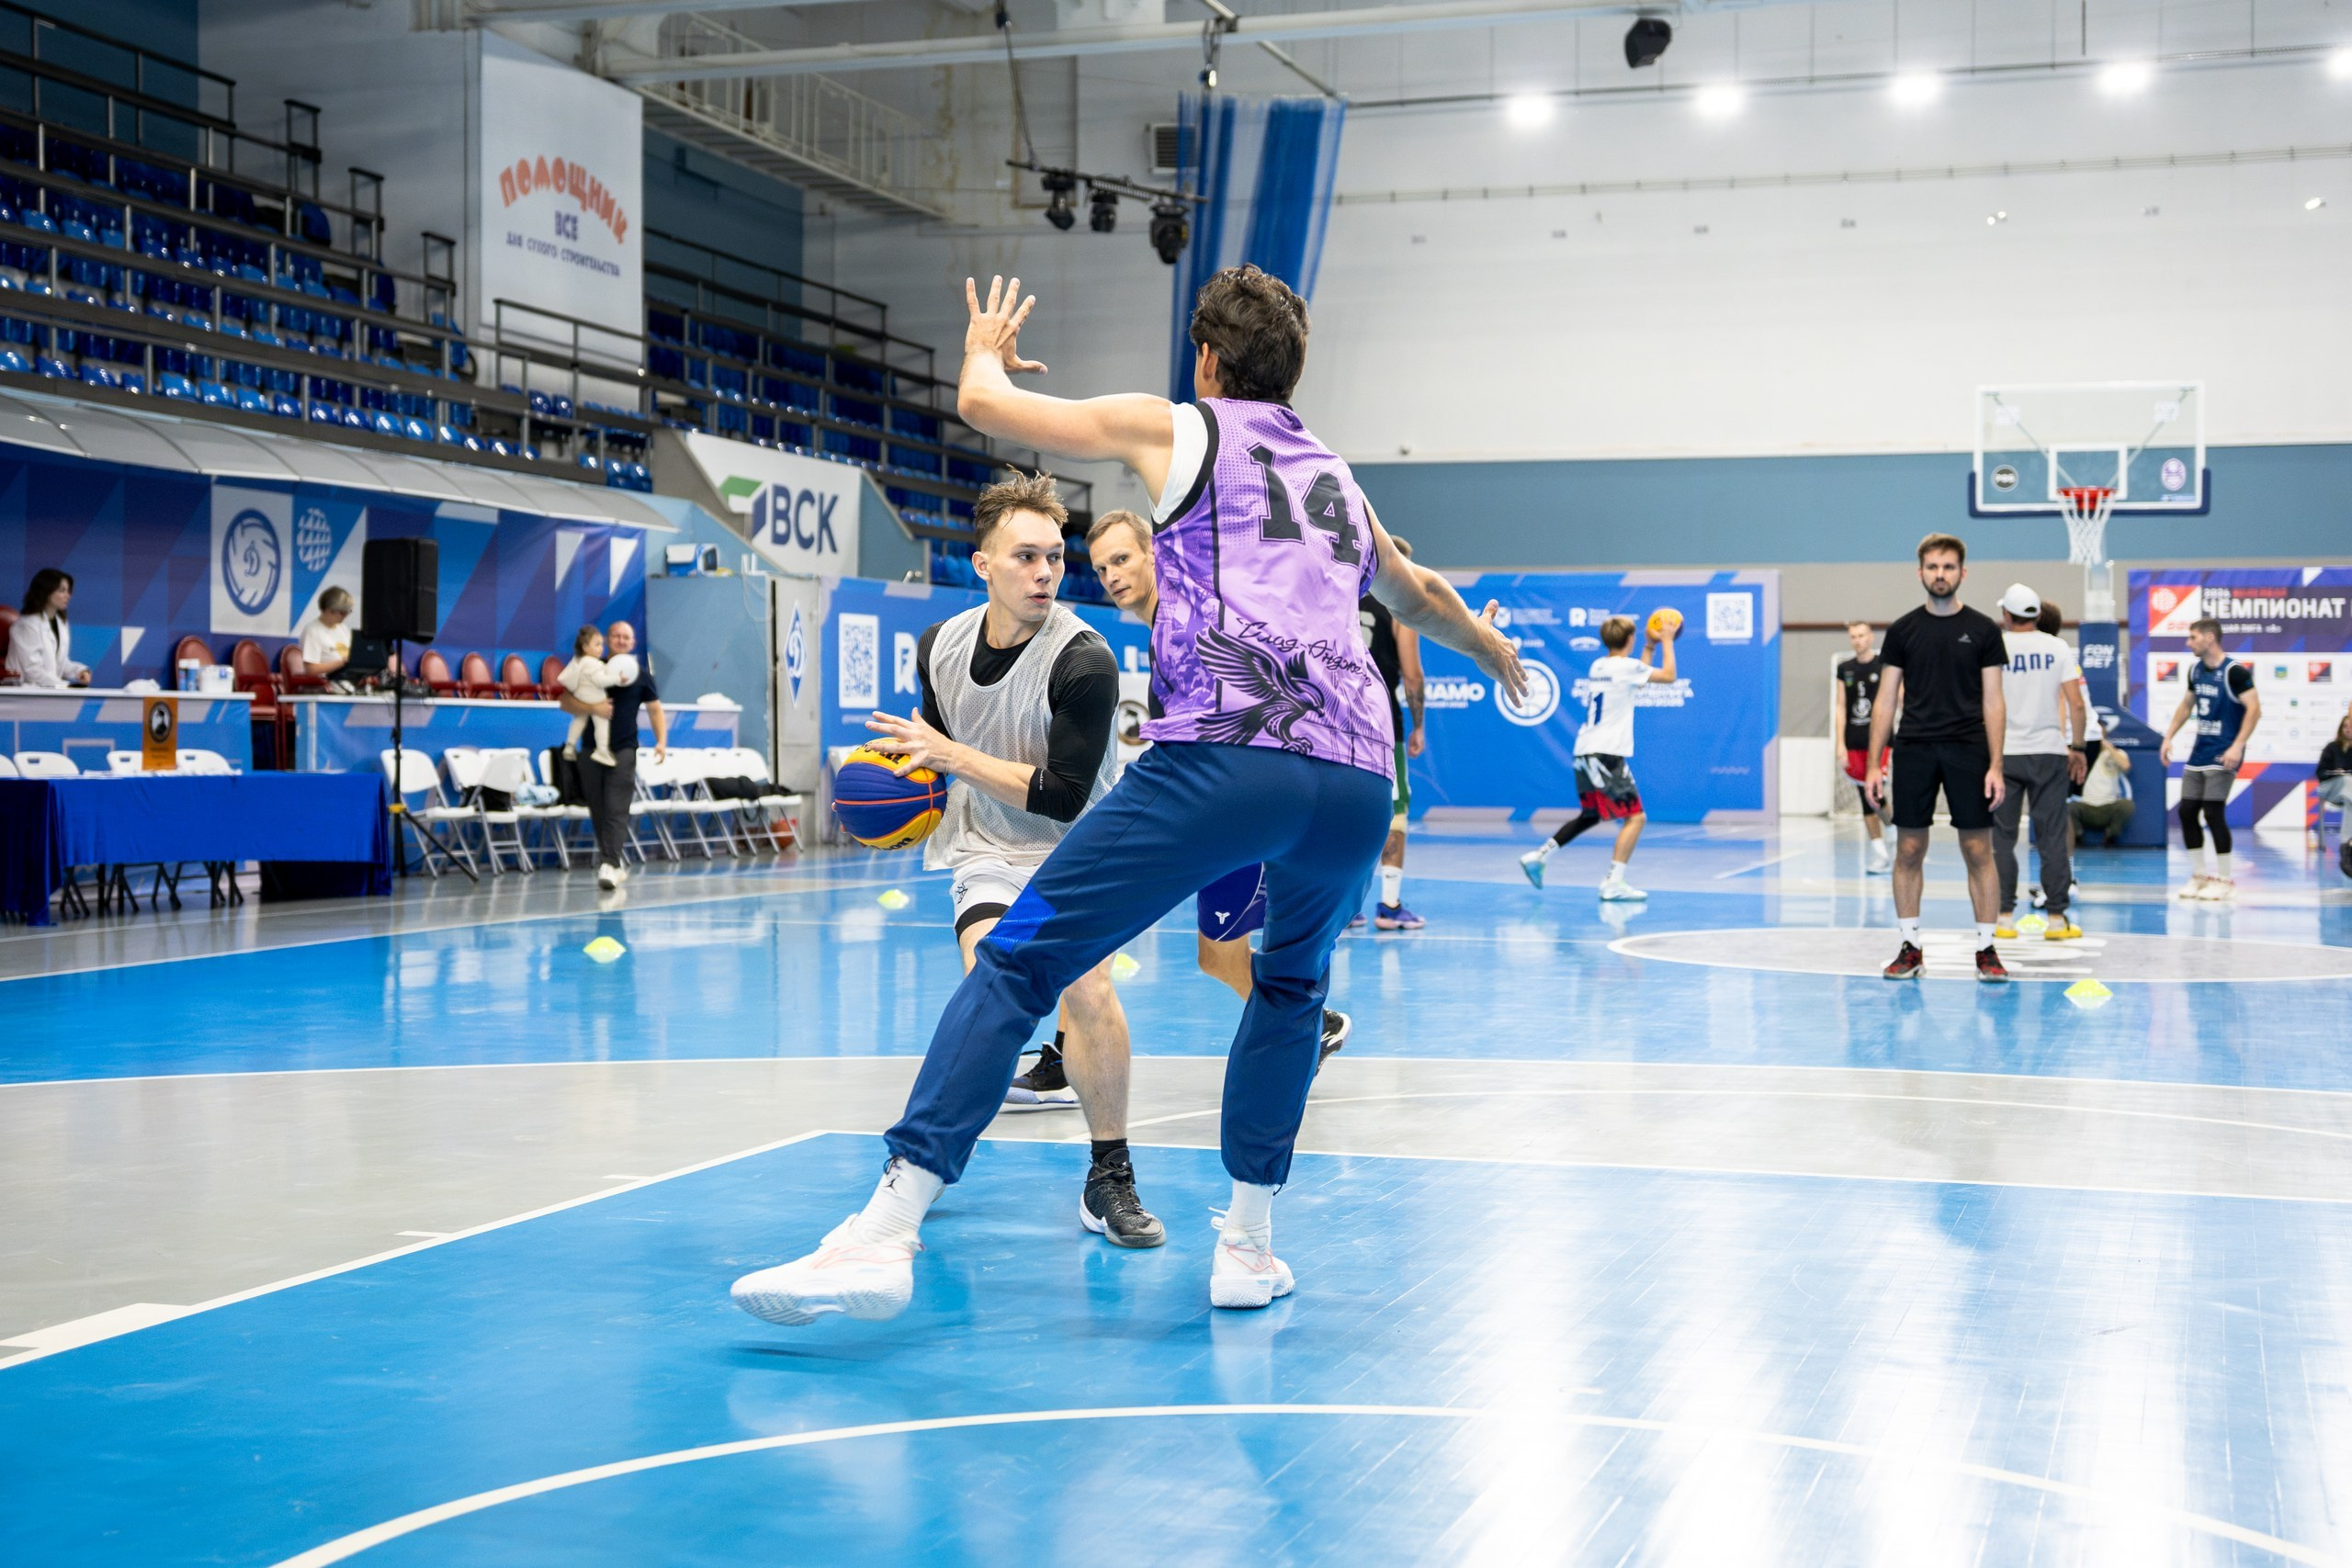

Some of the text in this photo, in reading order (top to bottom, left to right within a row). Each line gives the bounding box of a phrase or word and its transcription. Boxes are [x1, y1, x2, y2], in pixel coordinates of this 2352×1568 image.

[500, 154, 627, 244] ПОМОЩНИК
[555, 210, 578, 241] ВСЕ
[506, 231, 523, 248] ДЛЯ
[560, 247, 621, 277] СТРОИТЕЛЬСТВА
[1247, 442, 1362, 569] 14
[2202, 598, 2346, 619] ЧЕМПИОНАТ
[2199, 698, 2210, 716] 3
